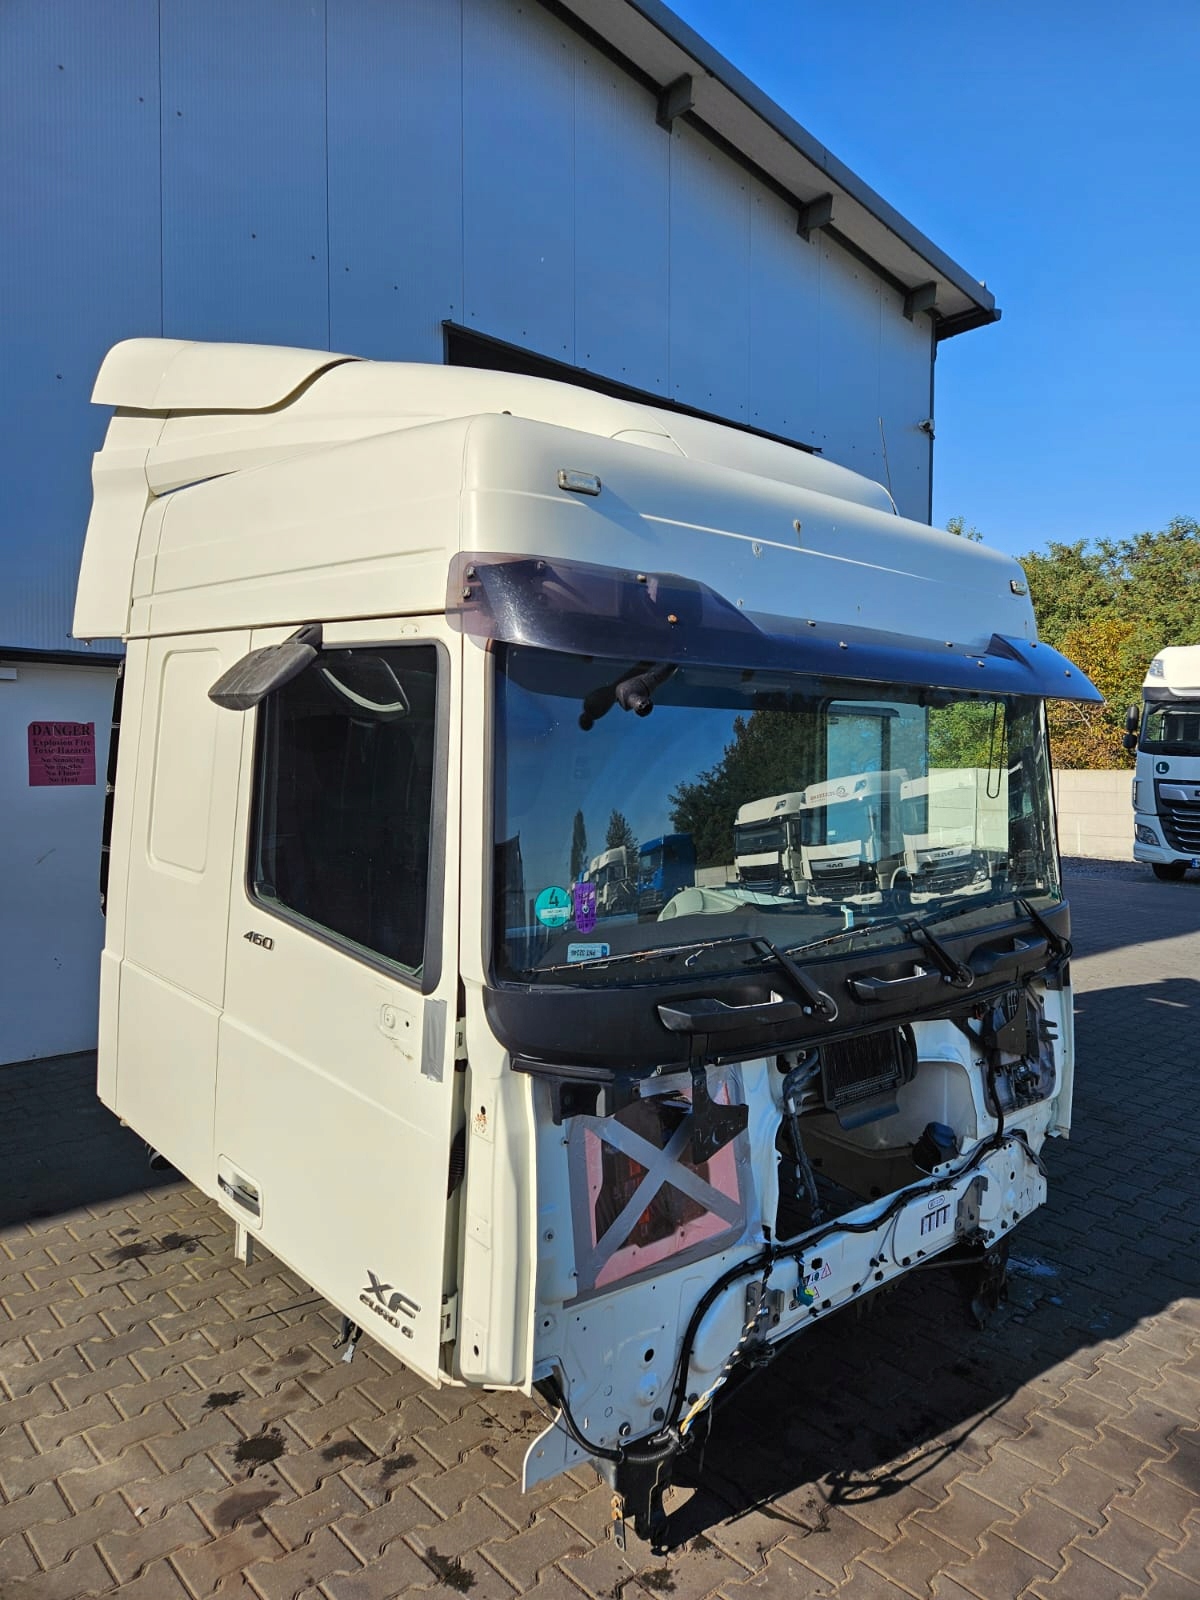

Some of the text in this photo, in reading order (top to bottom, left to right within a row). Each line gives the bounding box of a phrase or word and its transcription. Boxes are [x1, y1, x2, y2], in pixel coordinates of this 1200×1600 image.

[32, 725, 90, 736] DANGER
[33, 739, 73, 747] Explosion
[1159, 763, 1167, 773] L
[549, 889, 560, 906] 4
[243, 931, 274, 951] 460
[362, 1269, 422, 1319] XF
[359, 1294, 415, 1340] EURO 6
